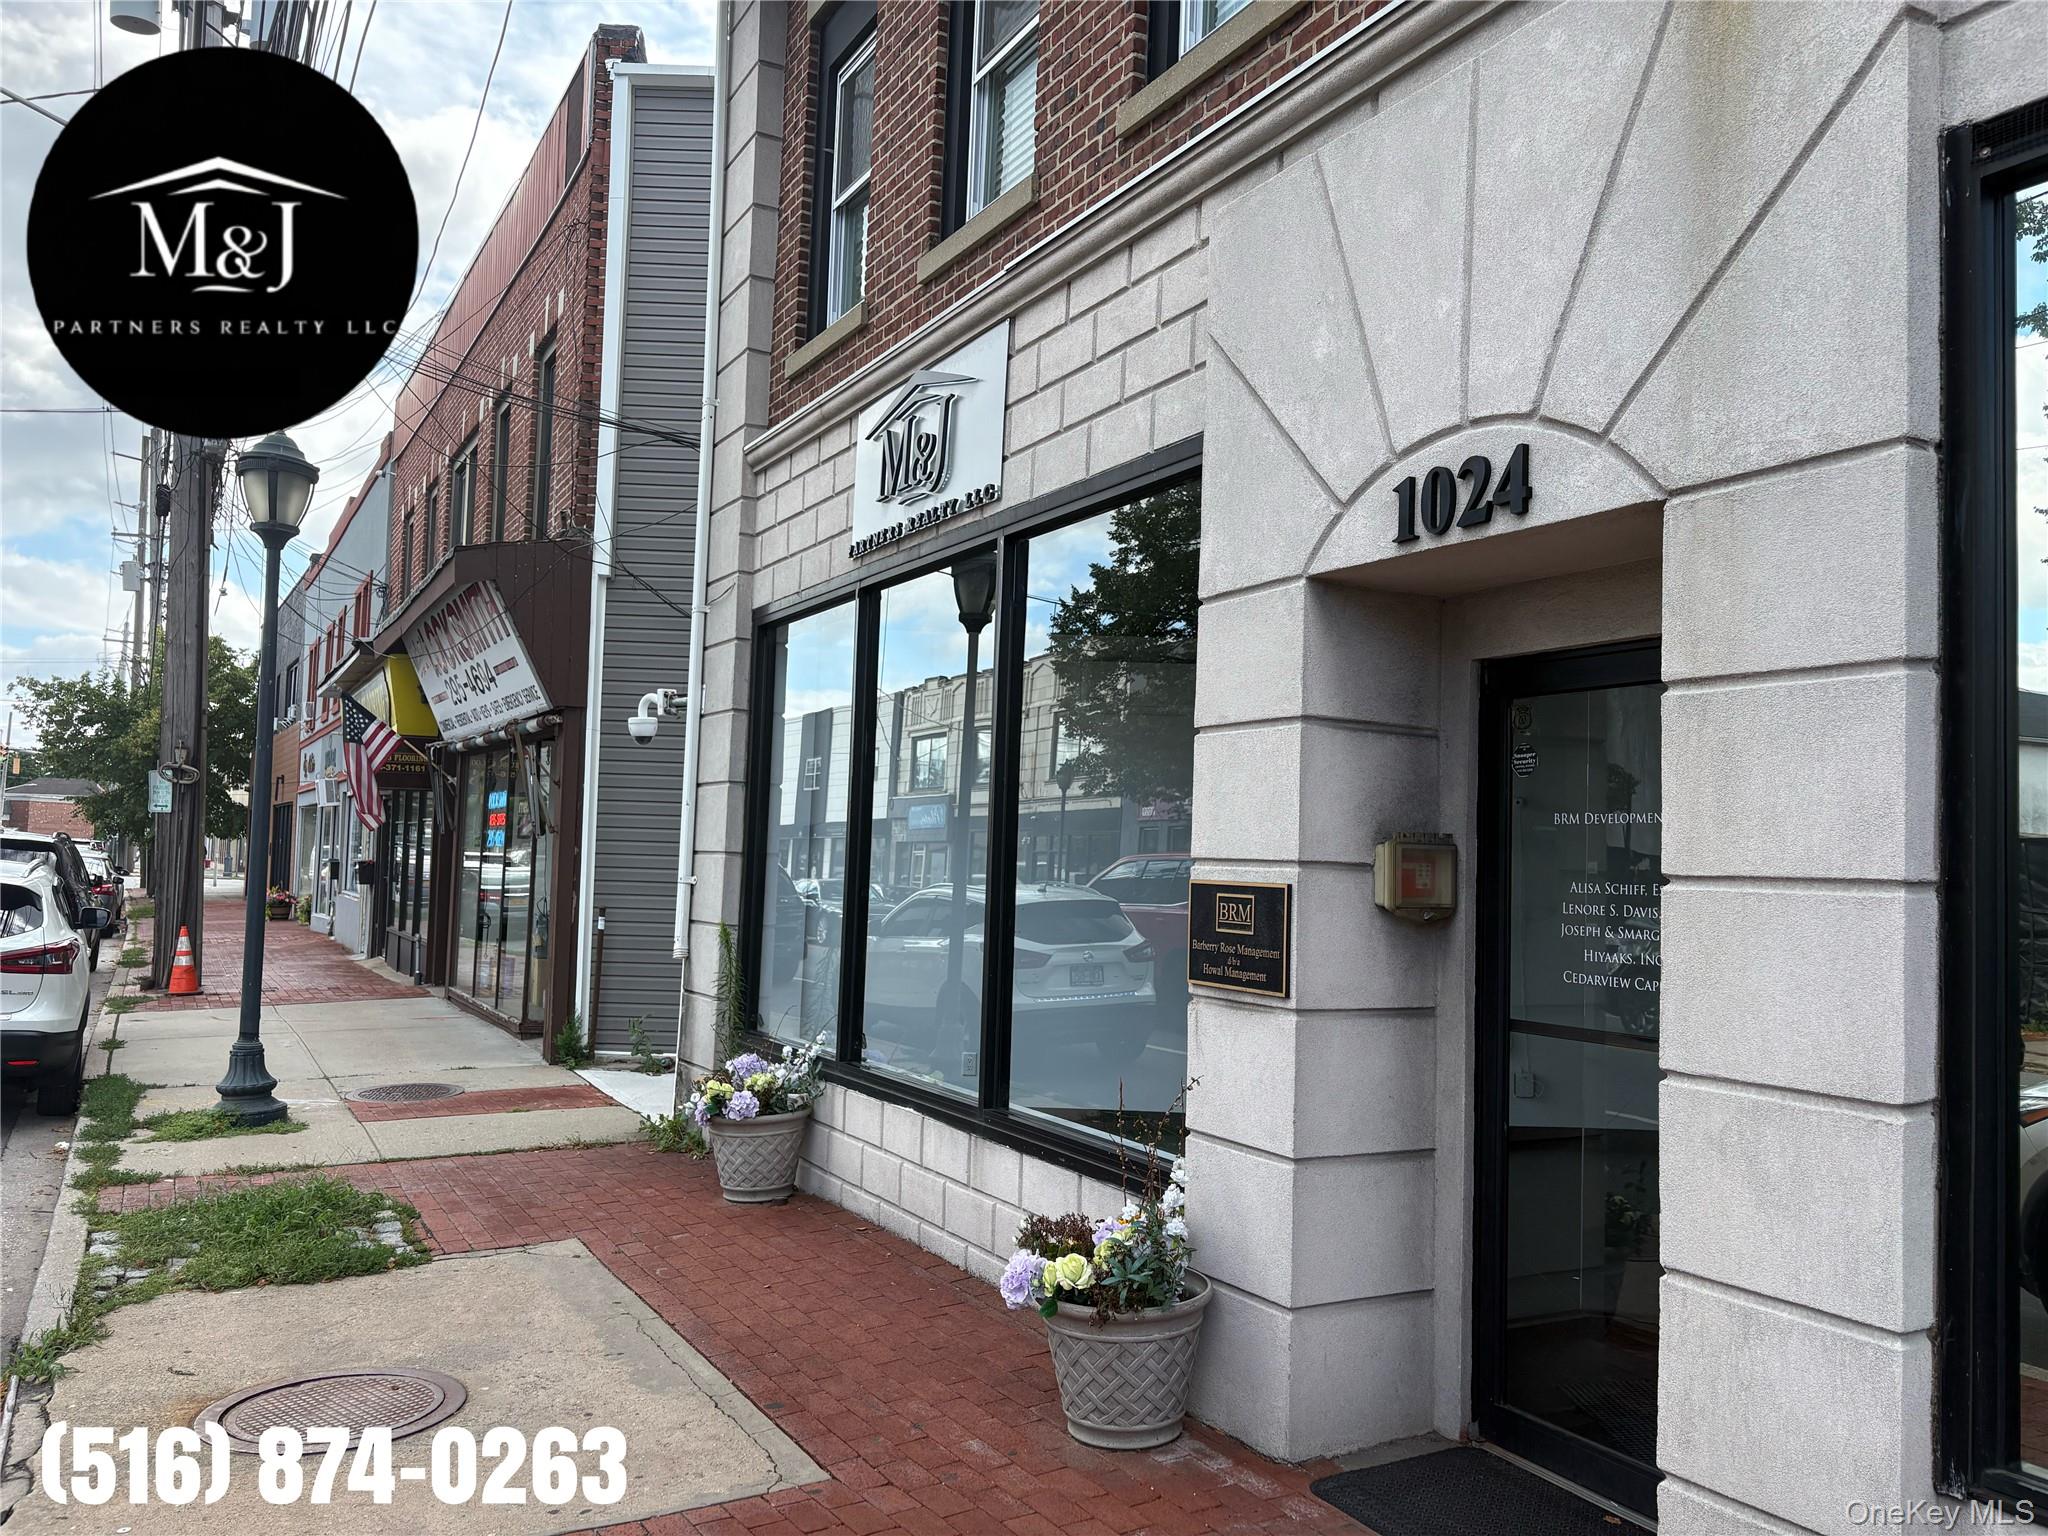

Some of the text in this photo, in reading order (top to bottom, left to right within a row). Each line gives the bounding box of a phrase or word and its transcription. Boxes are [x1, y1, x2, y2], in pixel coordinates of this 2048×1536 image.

[878, 395, 957, 503] M&J
[1392, 443, 1533, 544] 1024
[848, 483, 1000, 560] PARTNERS REALTY LLC
[419, 580, 511, 678] LOCKSMITH
[444, 658, 499, 706] 295-4694
[380, 763, 426, 772] -371-1161
[1554, 812, 1662, 825] BRM DEVELOPMEN
[1570, 881, 1601, 894] ALISA
[1219, 903, 1251, 922] BRM
[1562, 901, 1606, 916] LENORE
[1609, 903, 1619, 917] S.
[1561, 923, 1660, 941] JOSEPH & SMARG
[1192, 939, 1281, 960] Barberry Rose Management
[1203, 963, 1267, 982] Howal Management
[1563, 970, 1660, 992] CEDARVIEW CAP
